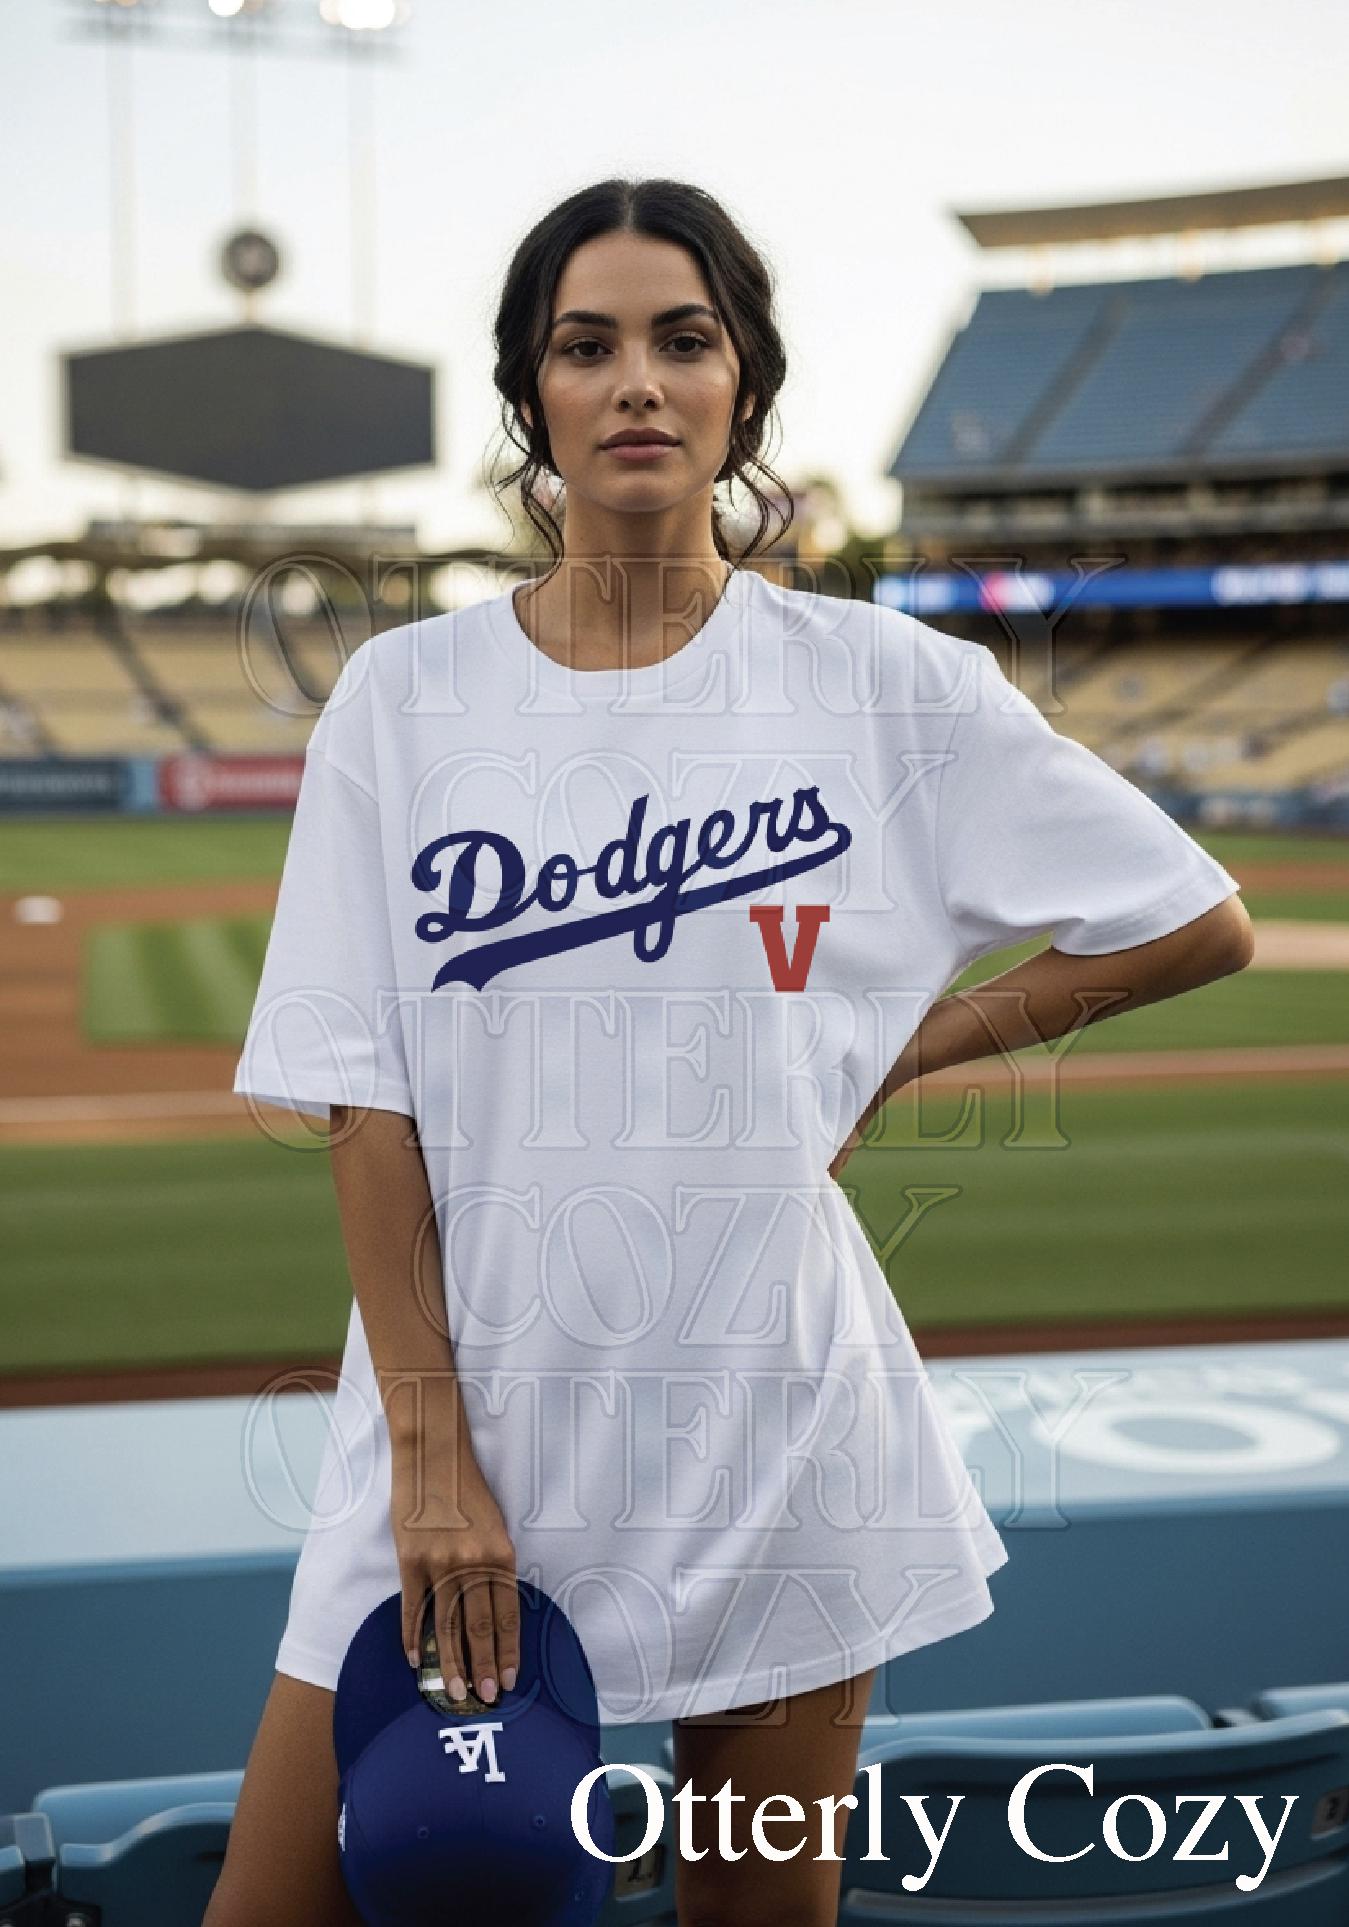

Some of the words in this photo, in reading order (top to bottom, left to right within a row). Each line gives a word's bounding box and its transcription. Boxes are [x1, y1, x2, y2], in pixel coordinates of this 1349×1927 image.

[411, 785, 852, 992] Dodgers
[750, 905, 830, 992] V
[438, 1722, 505, 1783] LA
